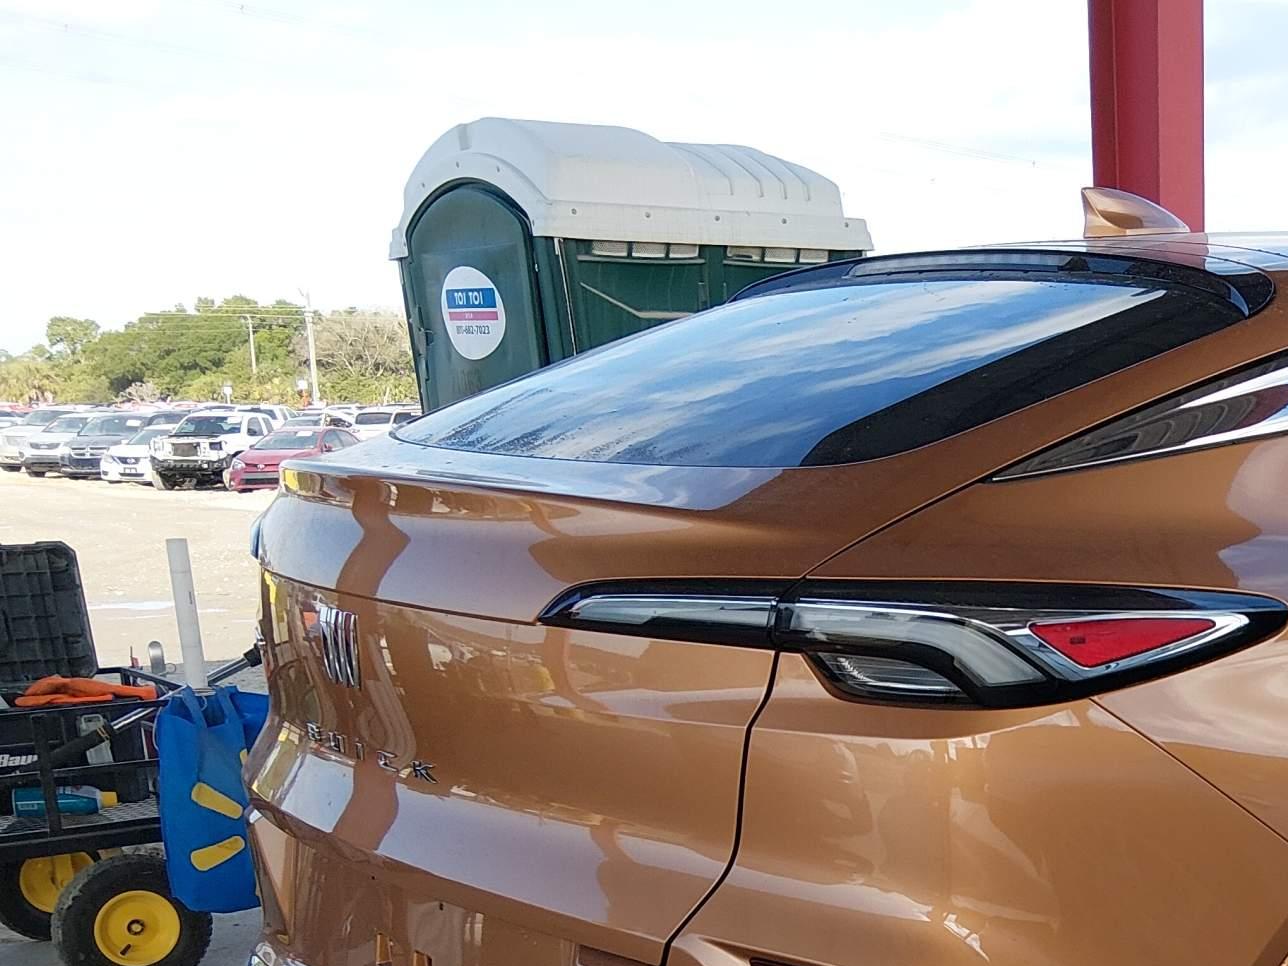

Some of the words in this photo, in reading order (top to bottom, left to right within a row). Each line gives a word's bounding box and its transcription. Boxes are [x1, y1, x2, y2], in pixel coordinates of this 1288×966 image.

[453, 291, 467, 305] TOI
[468, 291, 484, 305] TOI
[456, 325, 490, 335] -682-7023
[306, 721, 439, 784] BUICK
